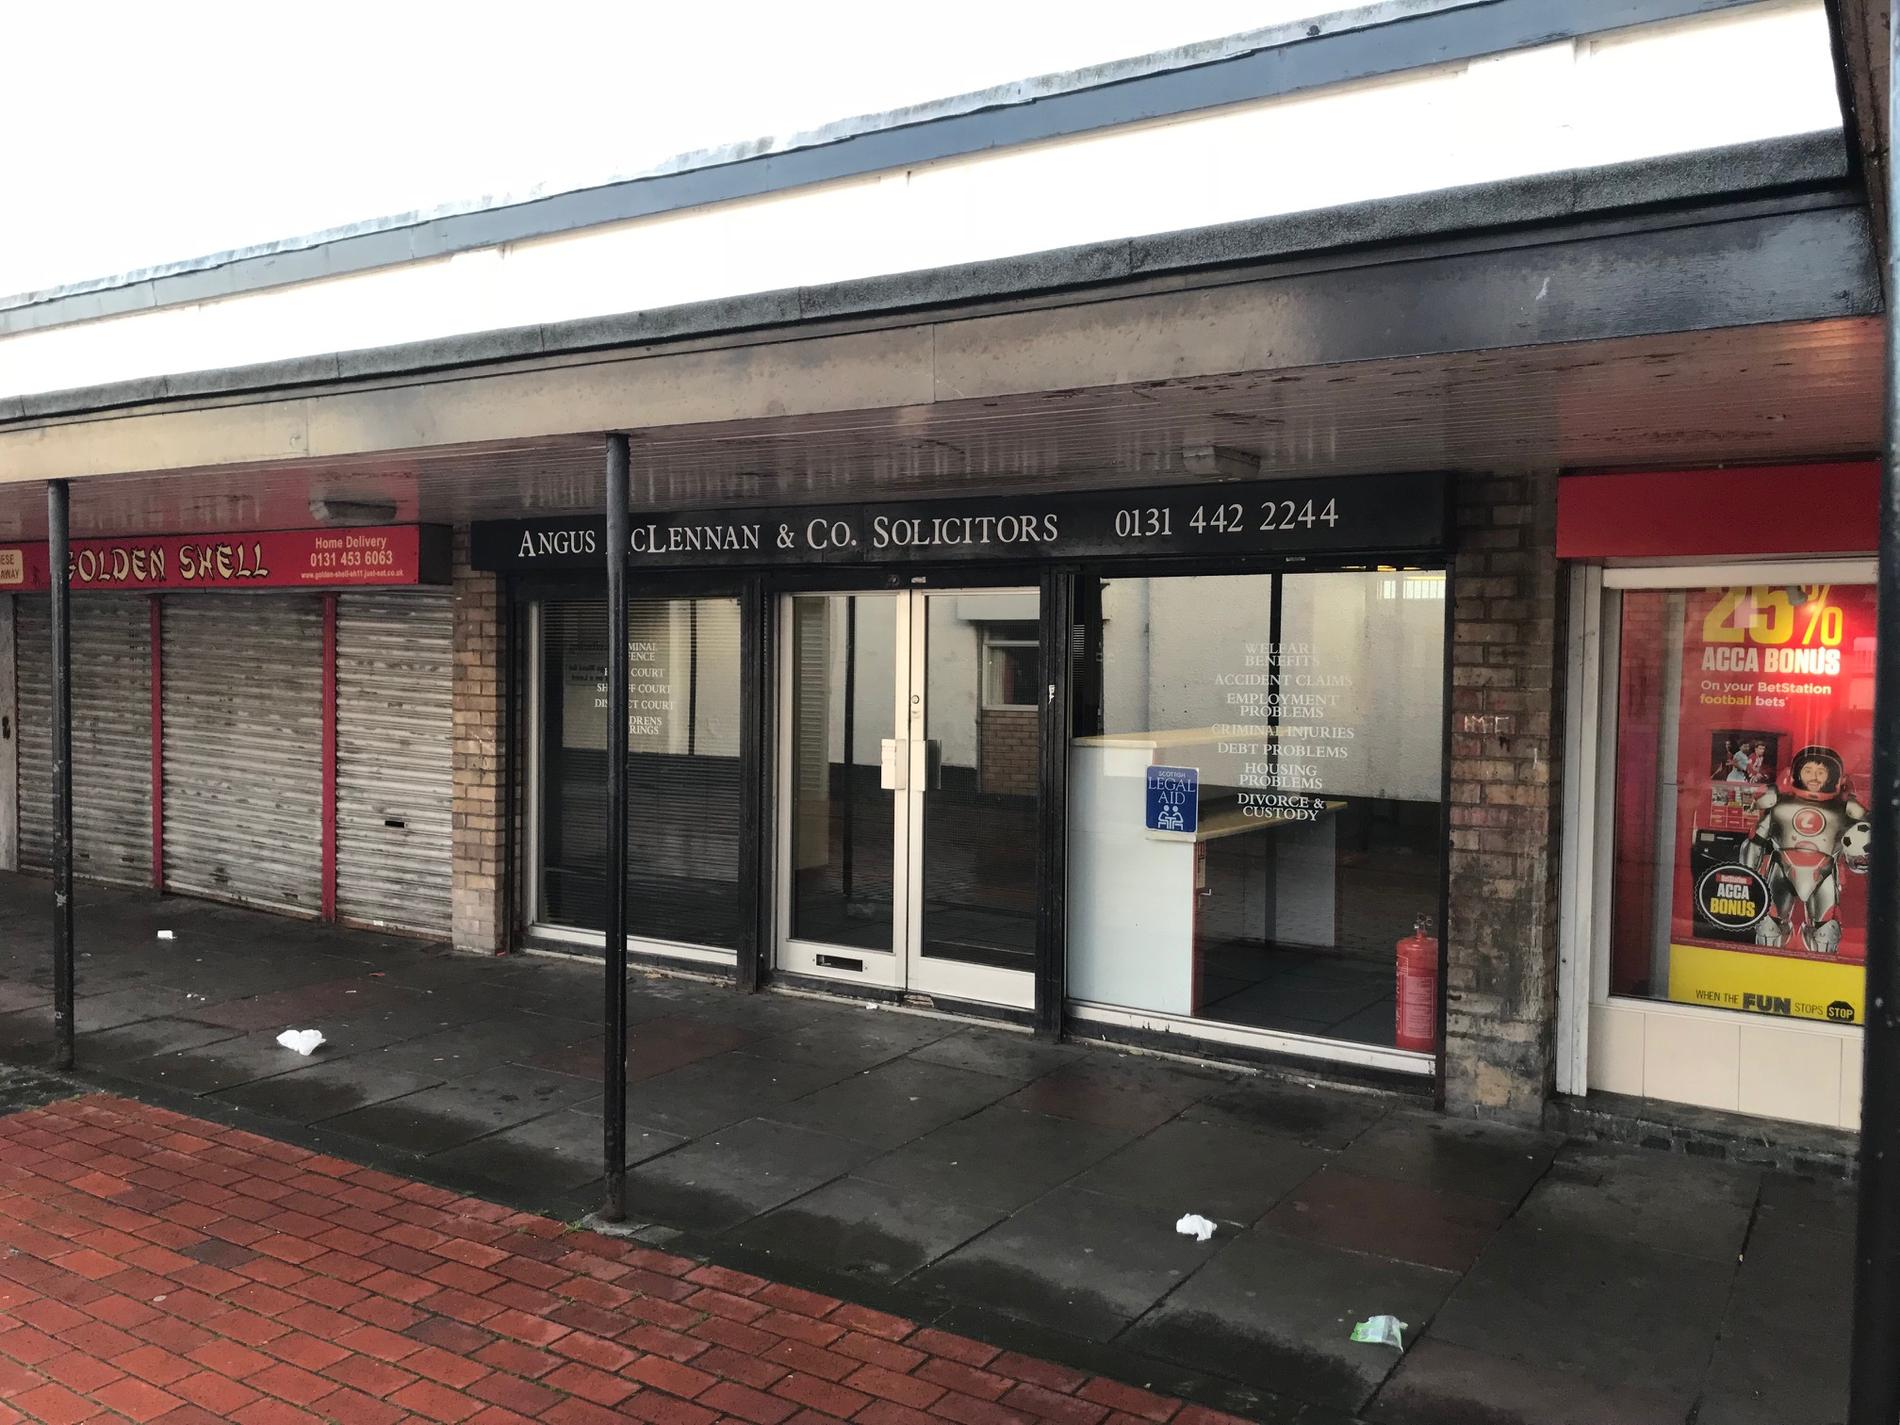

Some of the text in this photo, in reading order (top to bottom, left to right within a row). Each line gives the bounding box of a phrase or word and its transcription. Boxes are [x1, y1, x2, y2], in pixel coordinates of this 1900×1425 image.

[518, 497, 1339, 557] ANGUS CLENNAN & CO. SOLICITORS 0131 442 2244
[315, 535, 387, 549] Home Delivery
[179, 543, 269, 580] SHELL
[310, 550, 393, 567] 0131 453 6063
[1702, 585, 1843, 646] 25%
[1245, 655, 1321, 667] BENEFITS
[1702, 646, 1841, 675] ACCA BONUS
[630, 667, 665, 677] COURT
[1215, 674, 1353, 687] ACCIDENT CLAIMS
[1701, 680, 1831, 695] On your BetStation
[638, 684, 671, 694] COURT
[641, 700, 673, 710] COURT
[1227, 692, 1340, 706] EMPLOYMENT
[1700, 693, 1752, 705] football
[1240, 706, 1324, 719] PROBLEMS
[1211, 723, 1355, 741] CRIMINAL INJURIES
[1217, 742, 1348, 758] DEBT PROBLEMS
[1245, 762, 1317, 776] HOUSING
[1148, 777, 1196, 792] LEGAL
[1239, 774, 1323, 789] PROBLEMS
[1158, 791, 1186, 805] AID
[1237, 793, 1325, 809] DIVORCE &
[1243, 806, 1319, 821] CUSTODY
[1717, 883, 1750, 900] ACCA
[1711, 897, 1755, 918] BONUS
[1695, 988, 1853, 1019] WHEN THE FUN STOPS STOP
